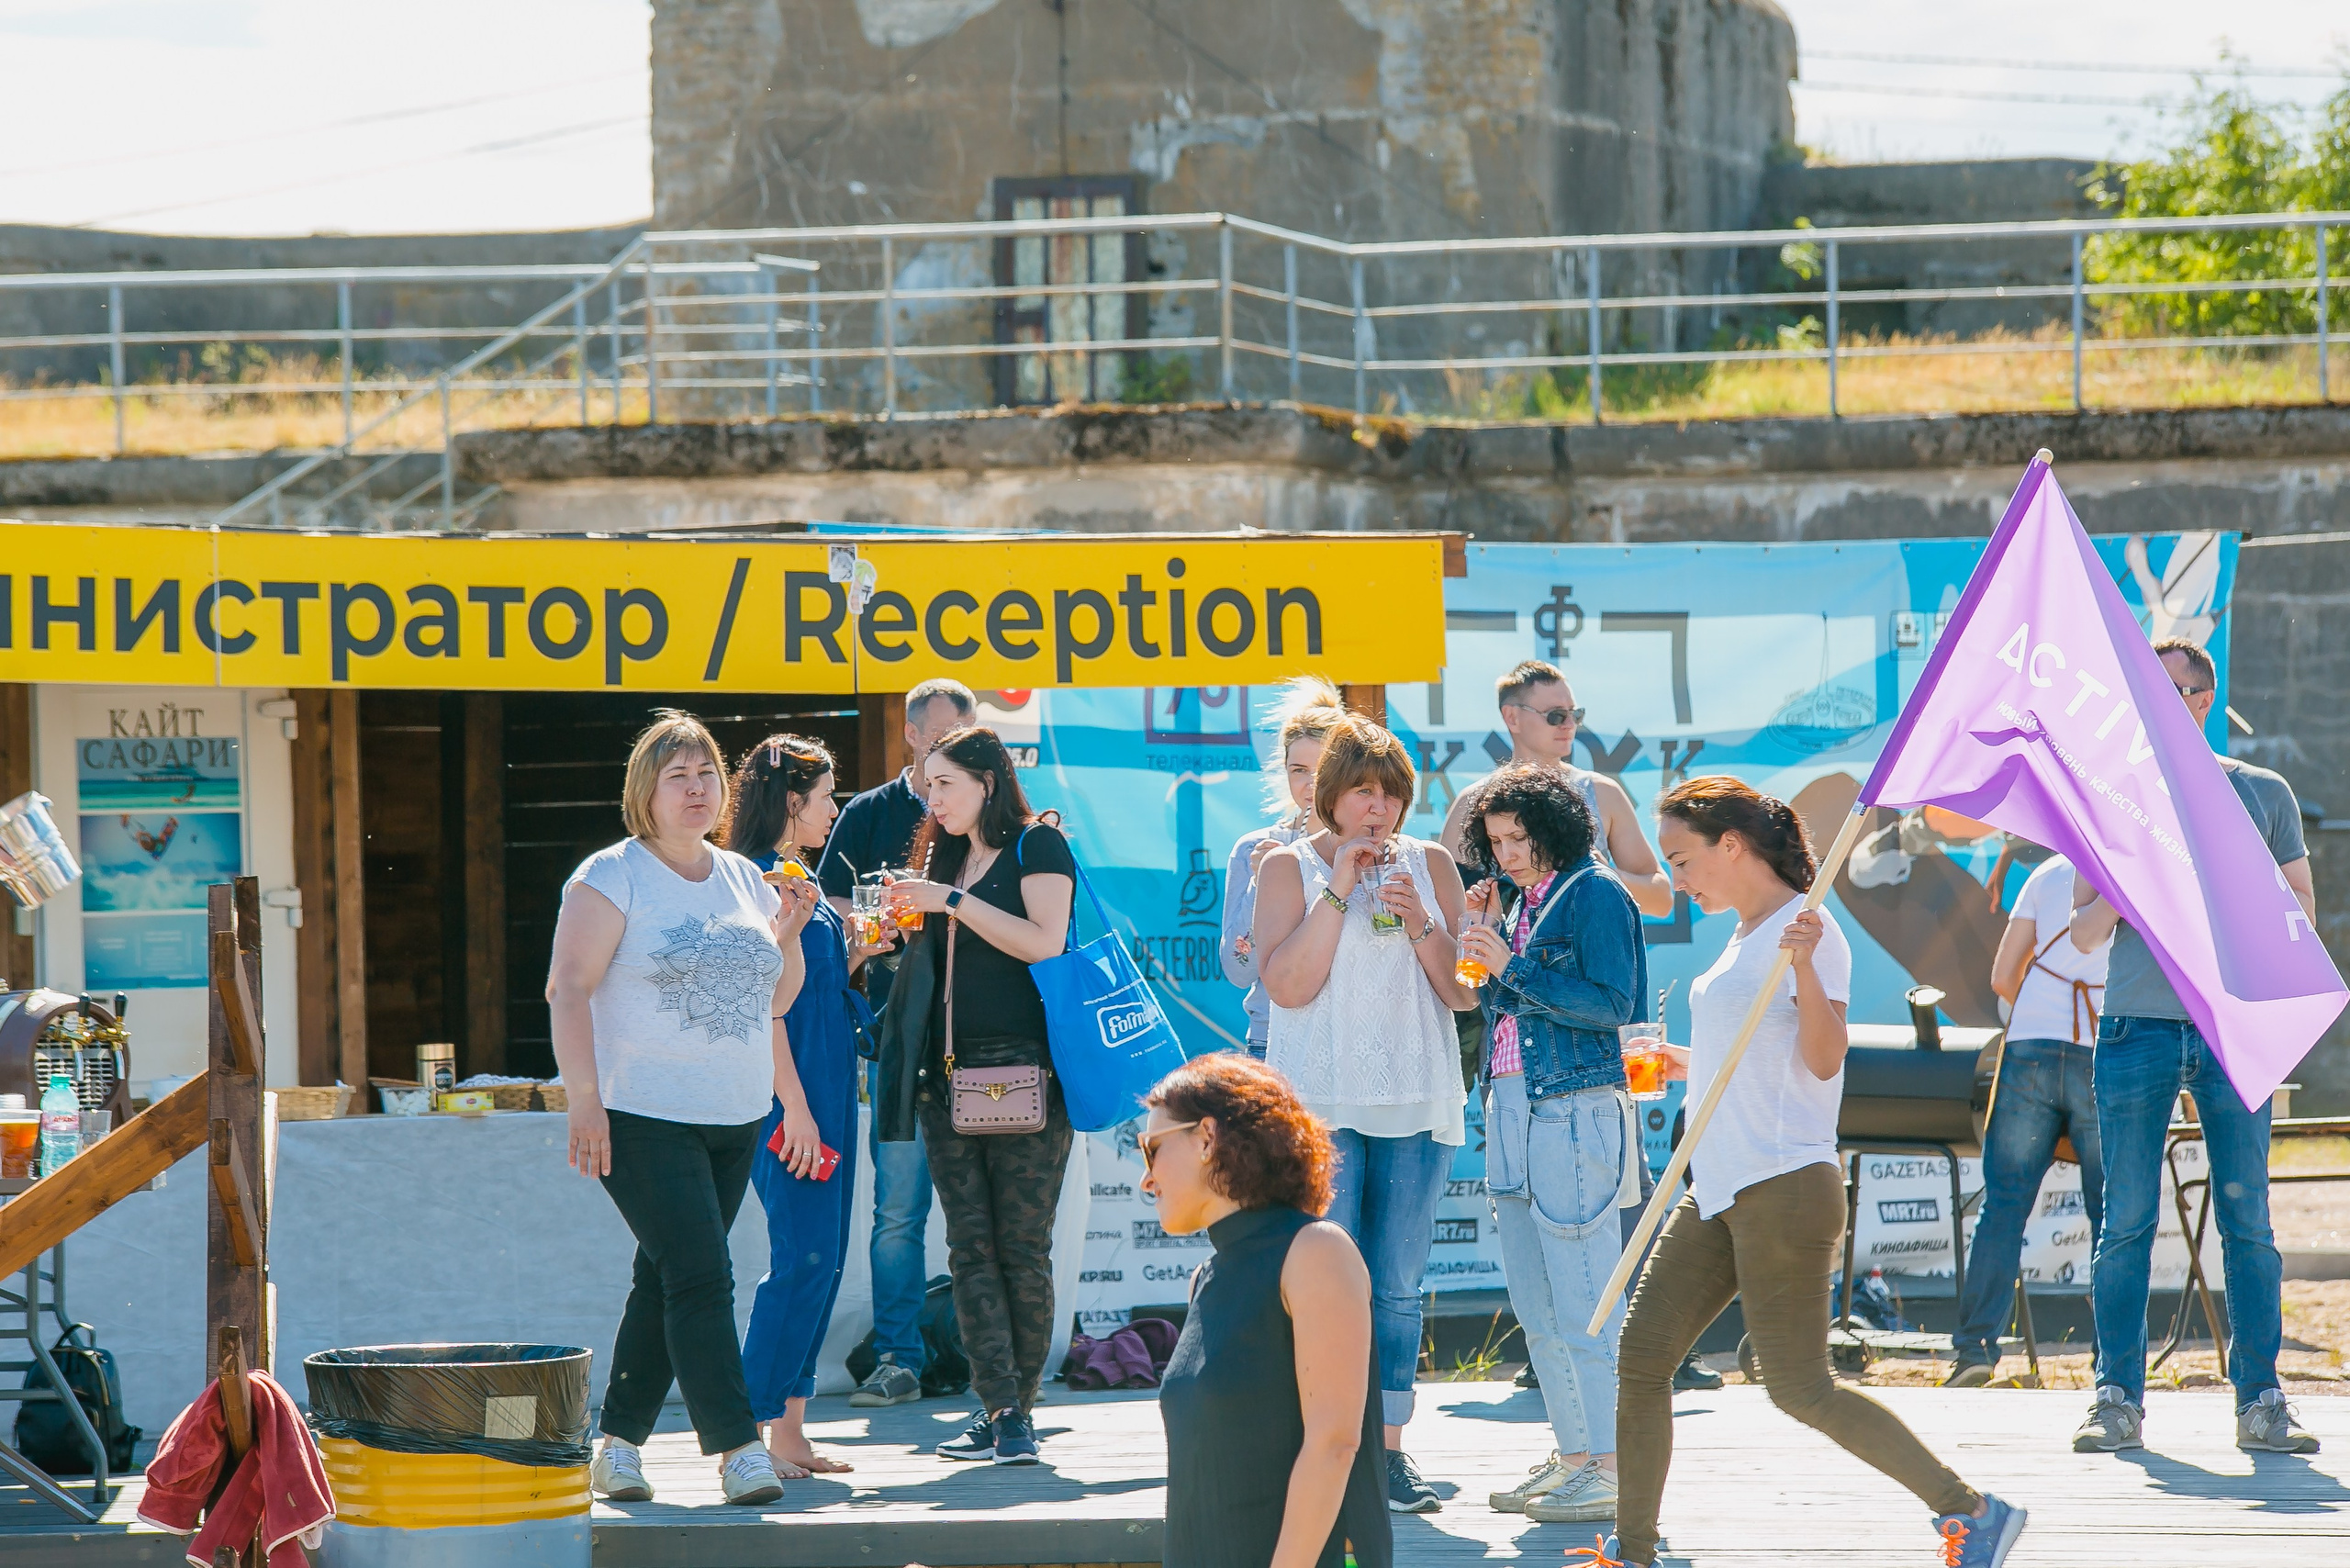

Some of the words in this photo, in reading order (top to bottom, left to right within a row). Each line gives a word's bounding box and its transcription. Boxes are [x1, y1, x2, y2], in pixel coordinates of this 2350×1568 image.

[785, 556, 1324, 684] Reception
[106, 701, 205, 738] КАЙТ
[1996, 622, 2172, 797] ACTIV
[83, 738, 230, 769] САФАРИ
[1147, 752, 1253, 771] телеканал
[1996, 700, 2040, 732] новый
[2088, 775, 2151, 828] качества
[1132, 934, 1230, 982] PETERBU
[1870, 1239, 1949, 1255] КИНОАФИША
